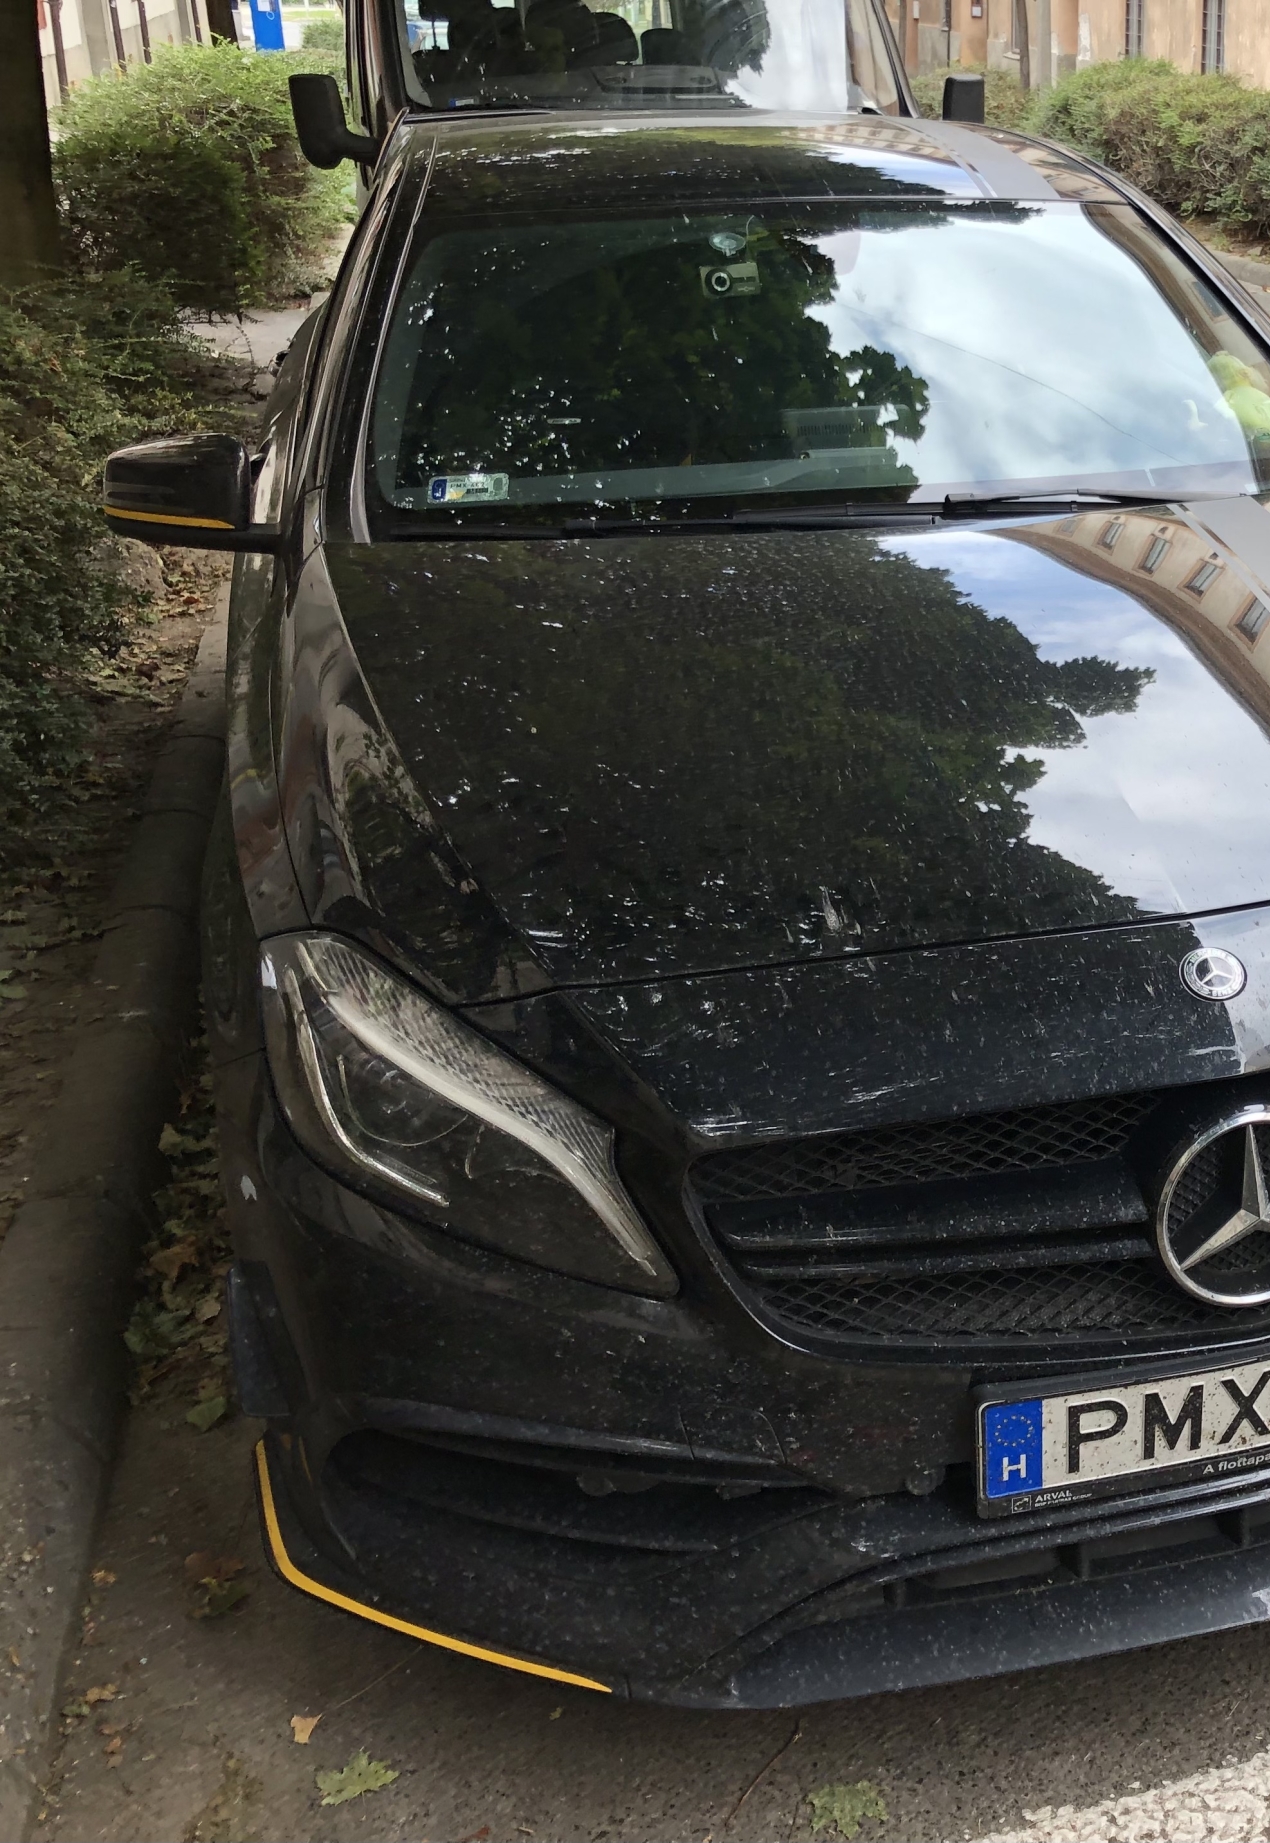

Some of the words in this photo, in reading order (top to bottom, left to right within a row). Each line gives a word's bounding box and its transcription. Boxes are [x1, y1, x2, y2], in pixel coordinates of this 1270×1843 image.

[1002, 1454, 1026, 1481] H
[1203, 1465, 1214, 1475] A
[1035, 1490, 1072, 1502] ARVAL
